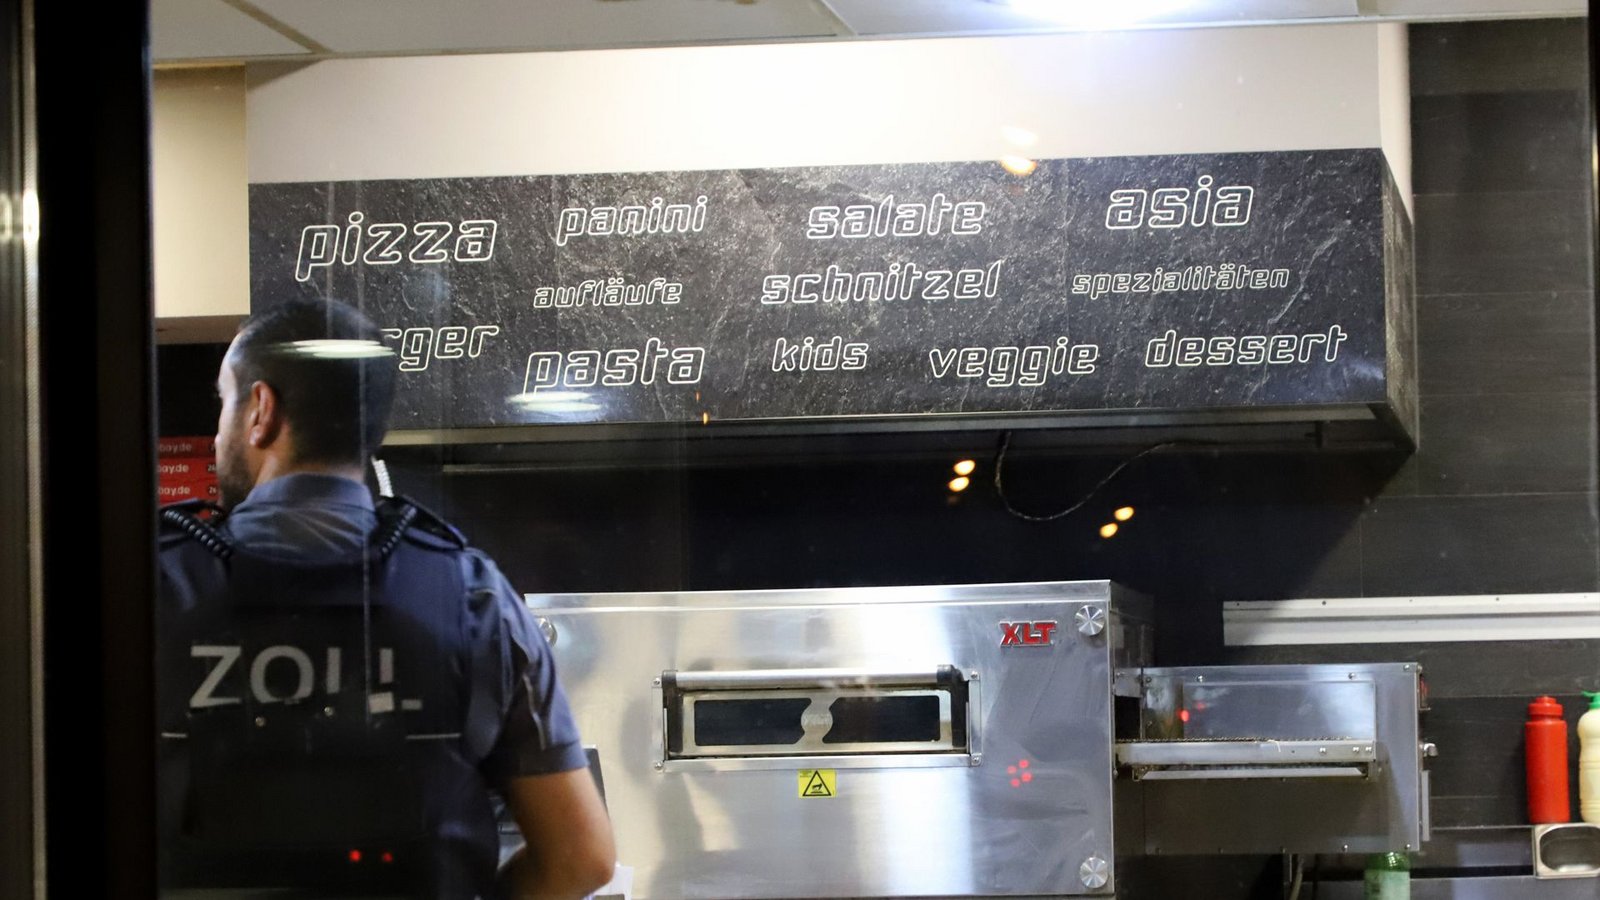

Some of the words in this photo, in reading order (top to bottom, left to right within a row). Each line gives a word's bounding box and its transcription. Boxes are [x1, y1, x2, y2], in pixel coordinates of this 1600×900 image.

[556, 195, 708, 246] panini
[806, 193, 986, 239] salate
[1105, 175, 1255, 230] asia
[294, 211, 498, 282] pizza
[533, 277, 683, 308] aufläufe
[760, 259, 1001, 305] schnitzel
[1072, 263, 1290, 300] spezialitäten
[522, 337, 706, 402] pasta
[771, 336, 869, 372] kids
[929, 336, 1099, 387] veggie
[1145, 325, 1348, 368] dessert
[999, 620, 1057, 647] XLT
